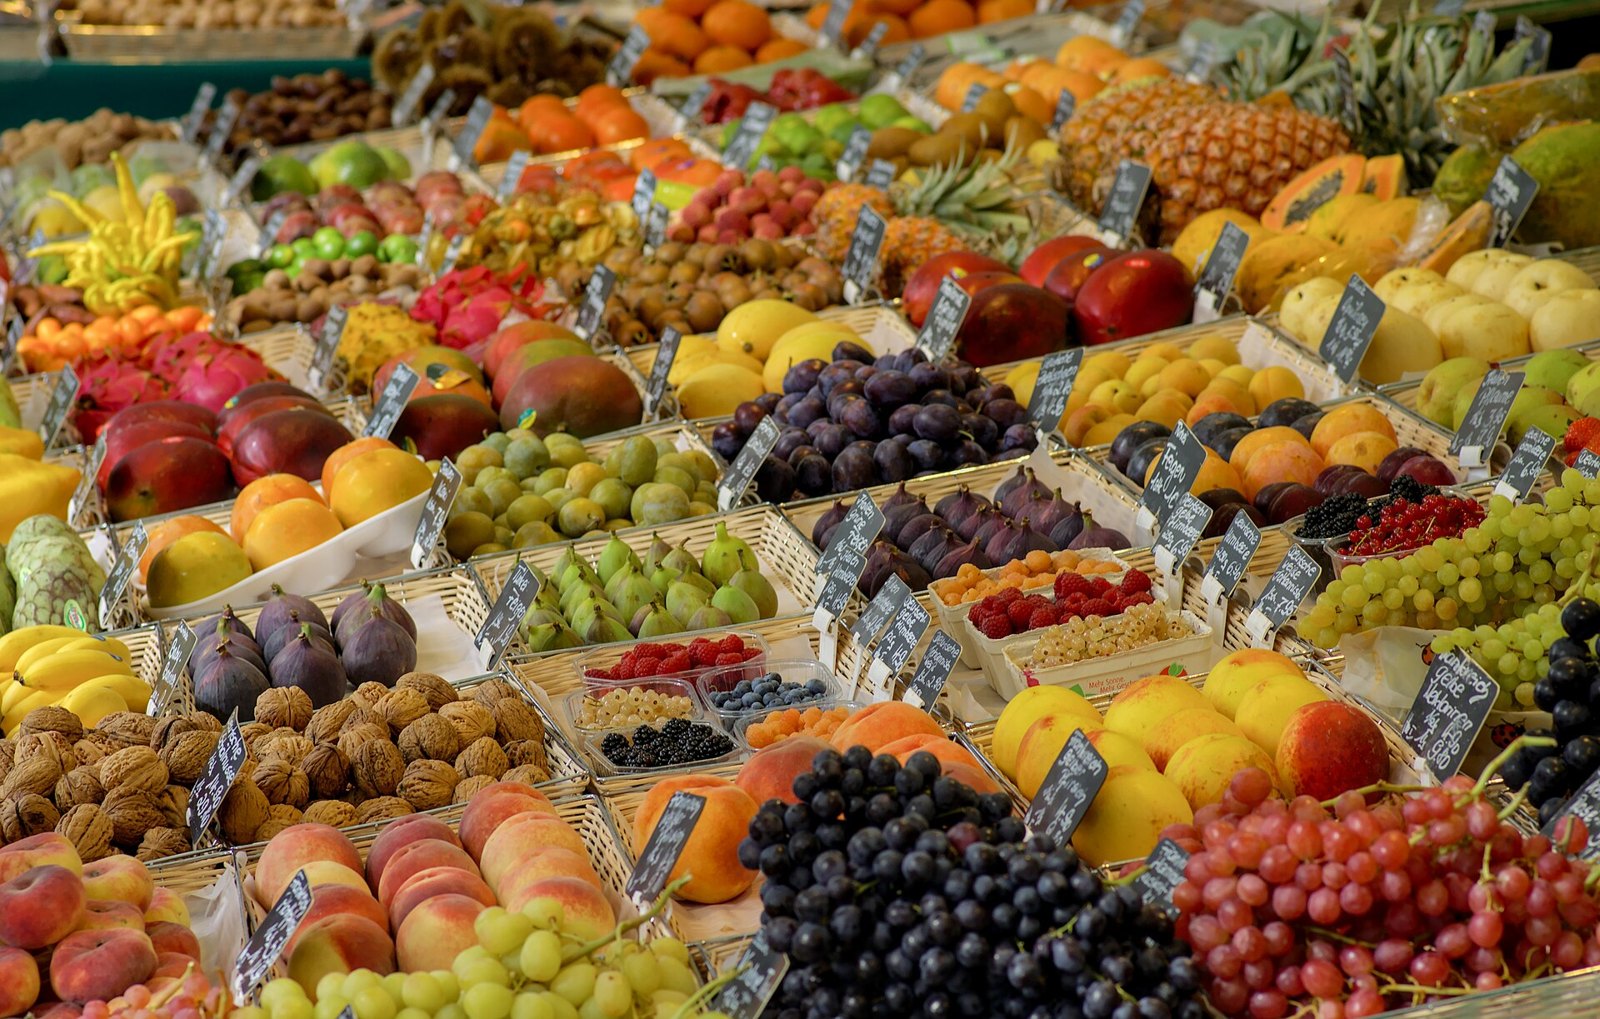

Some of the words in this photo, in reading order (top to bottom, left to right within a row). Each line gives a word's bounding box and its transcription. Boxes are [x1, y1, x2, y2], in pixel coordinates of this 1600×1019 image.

[1161, 442, 1185, 491] Feigen
[1225, 560, 1241, 580] 6.90
[1287, 545, 1316, 576] Deutsche
[896, 608, 915, 630] gelbe
[1089, 680, 1104, 689] Mehr
[1100, 685, 1115, 693] Mehr
[1431, 666, 1464, 698] gelbe
